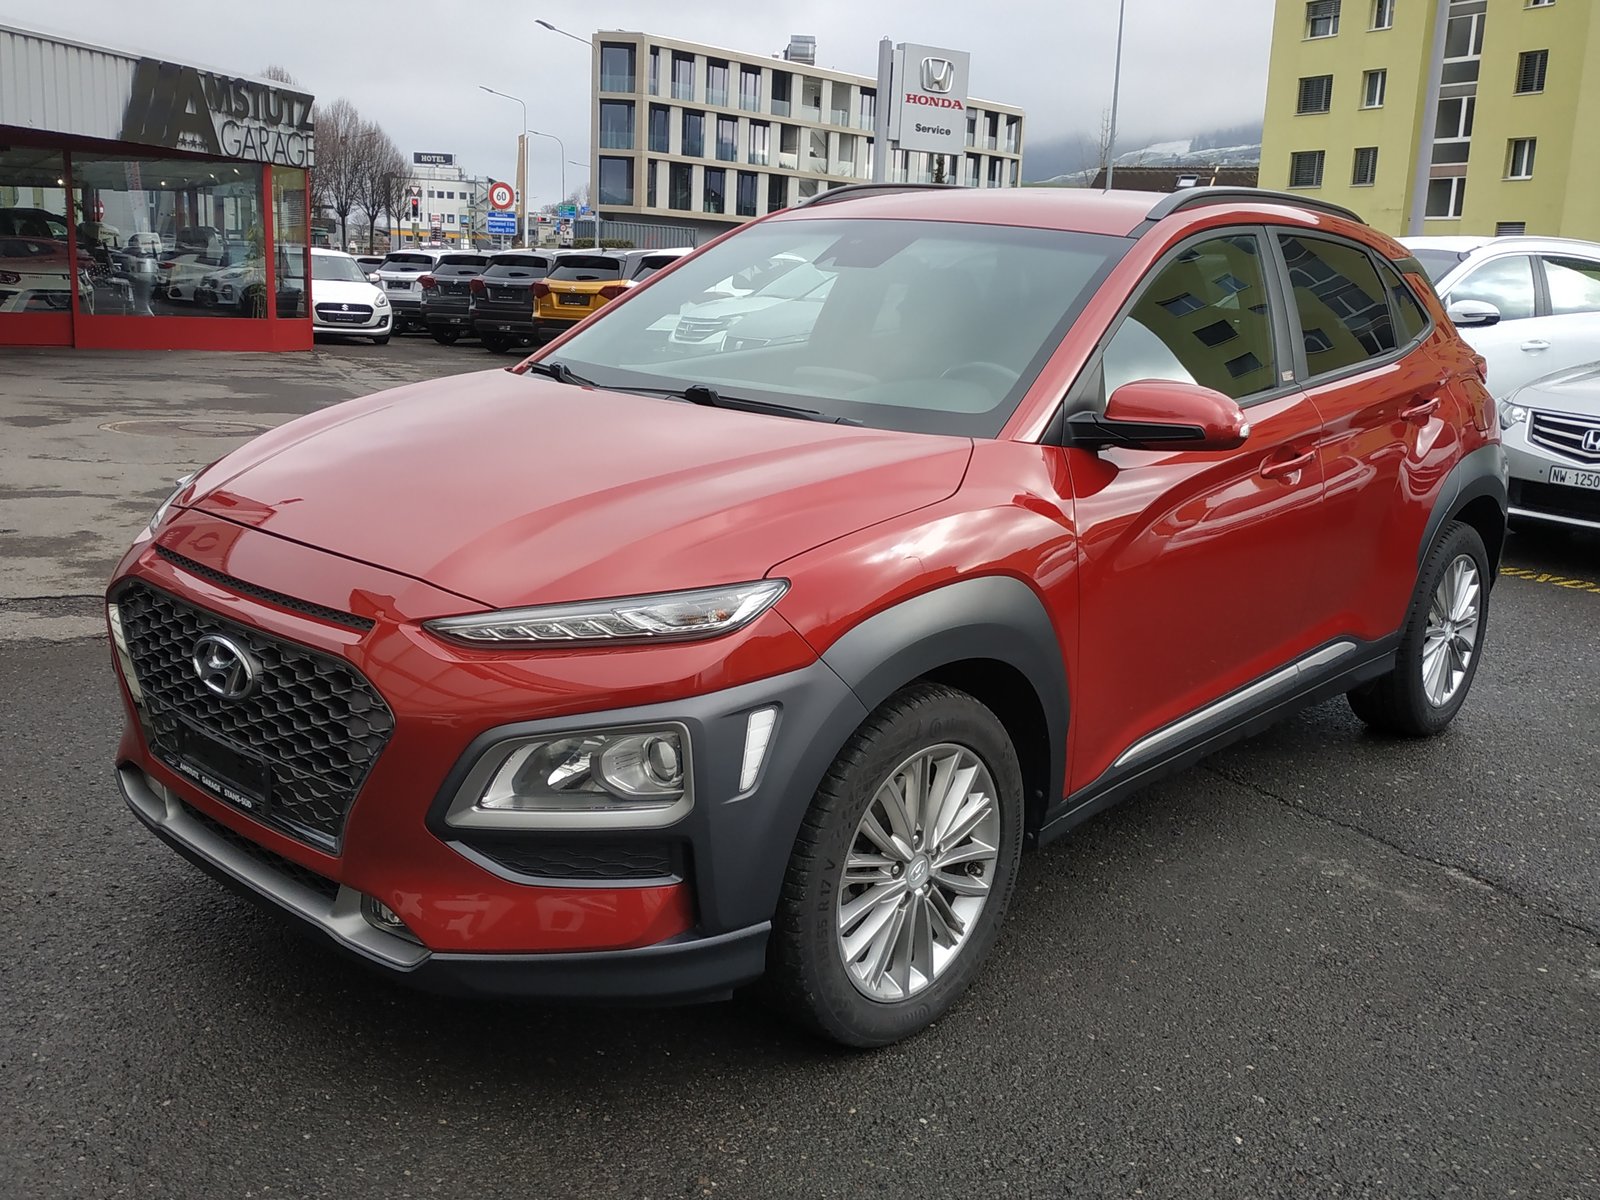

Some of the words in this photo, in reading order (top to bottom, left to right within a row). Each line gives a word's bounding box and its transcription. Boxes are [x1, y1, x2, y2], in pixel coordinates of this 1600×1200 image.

[905, 93, 964, 110] HONDA
[915, 123, 951, 136] Service
[220, 119, 315, 168] GARAGE
[421, 154, 446, 163] HOTEL
[496, 191, 507, 201] 60
[201, 775, 221, 793] GARAGE
[820, 879, 832, 897] 17
[817, 900, 830, 912] R
